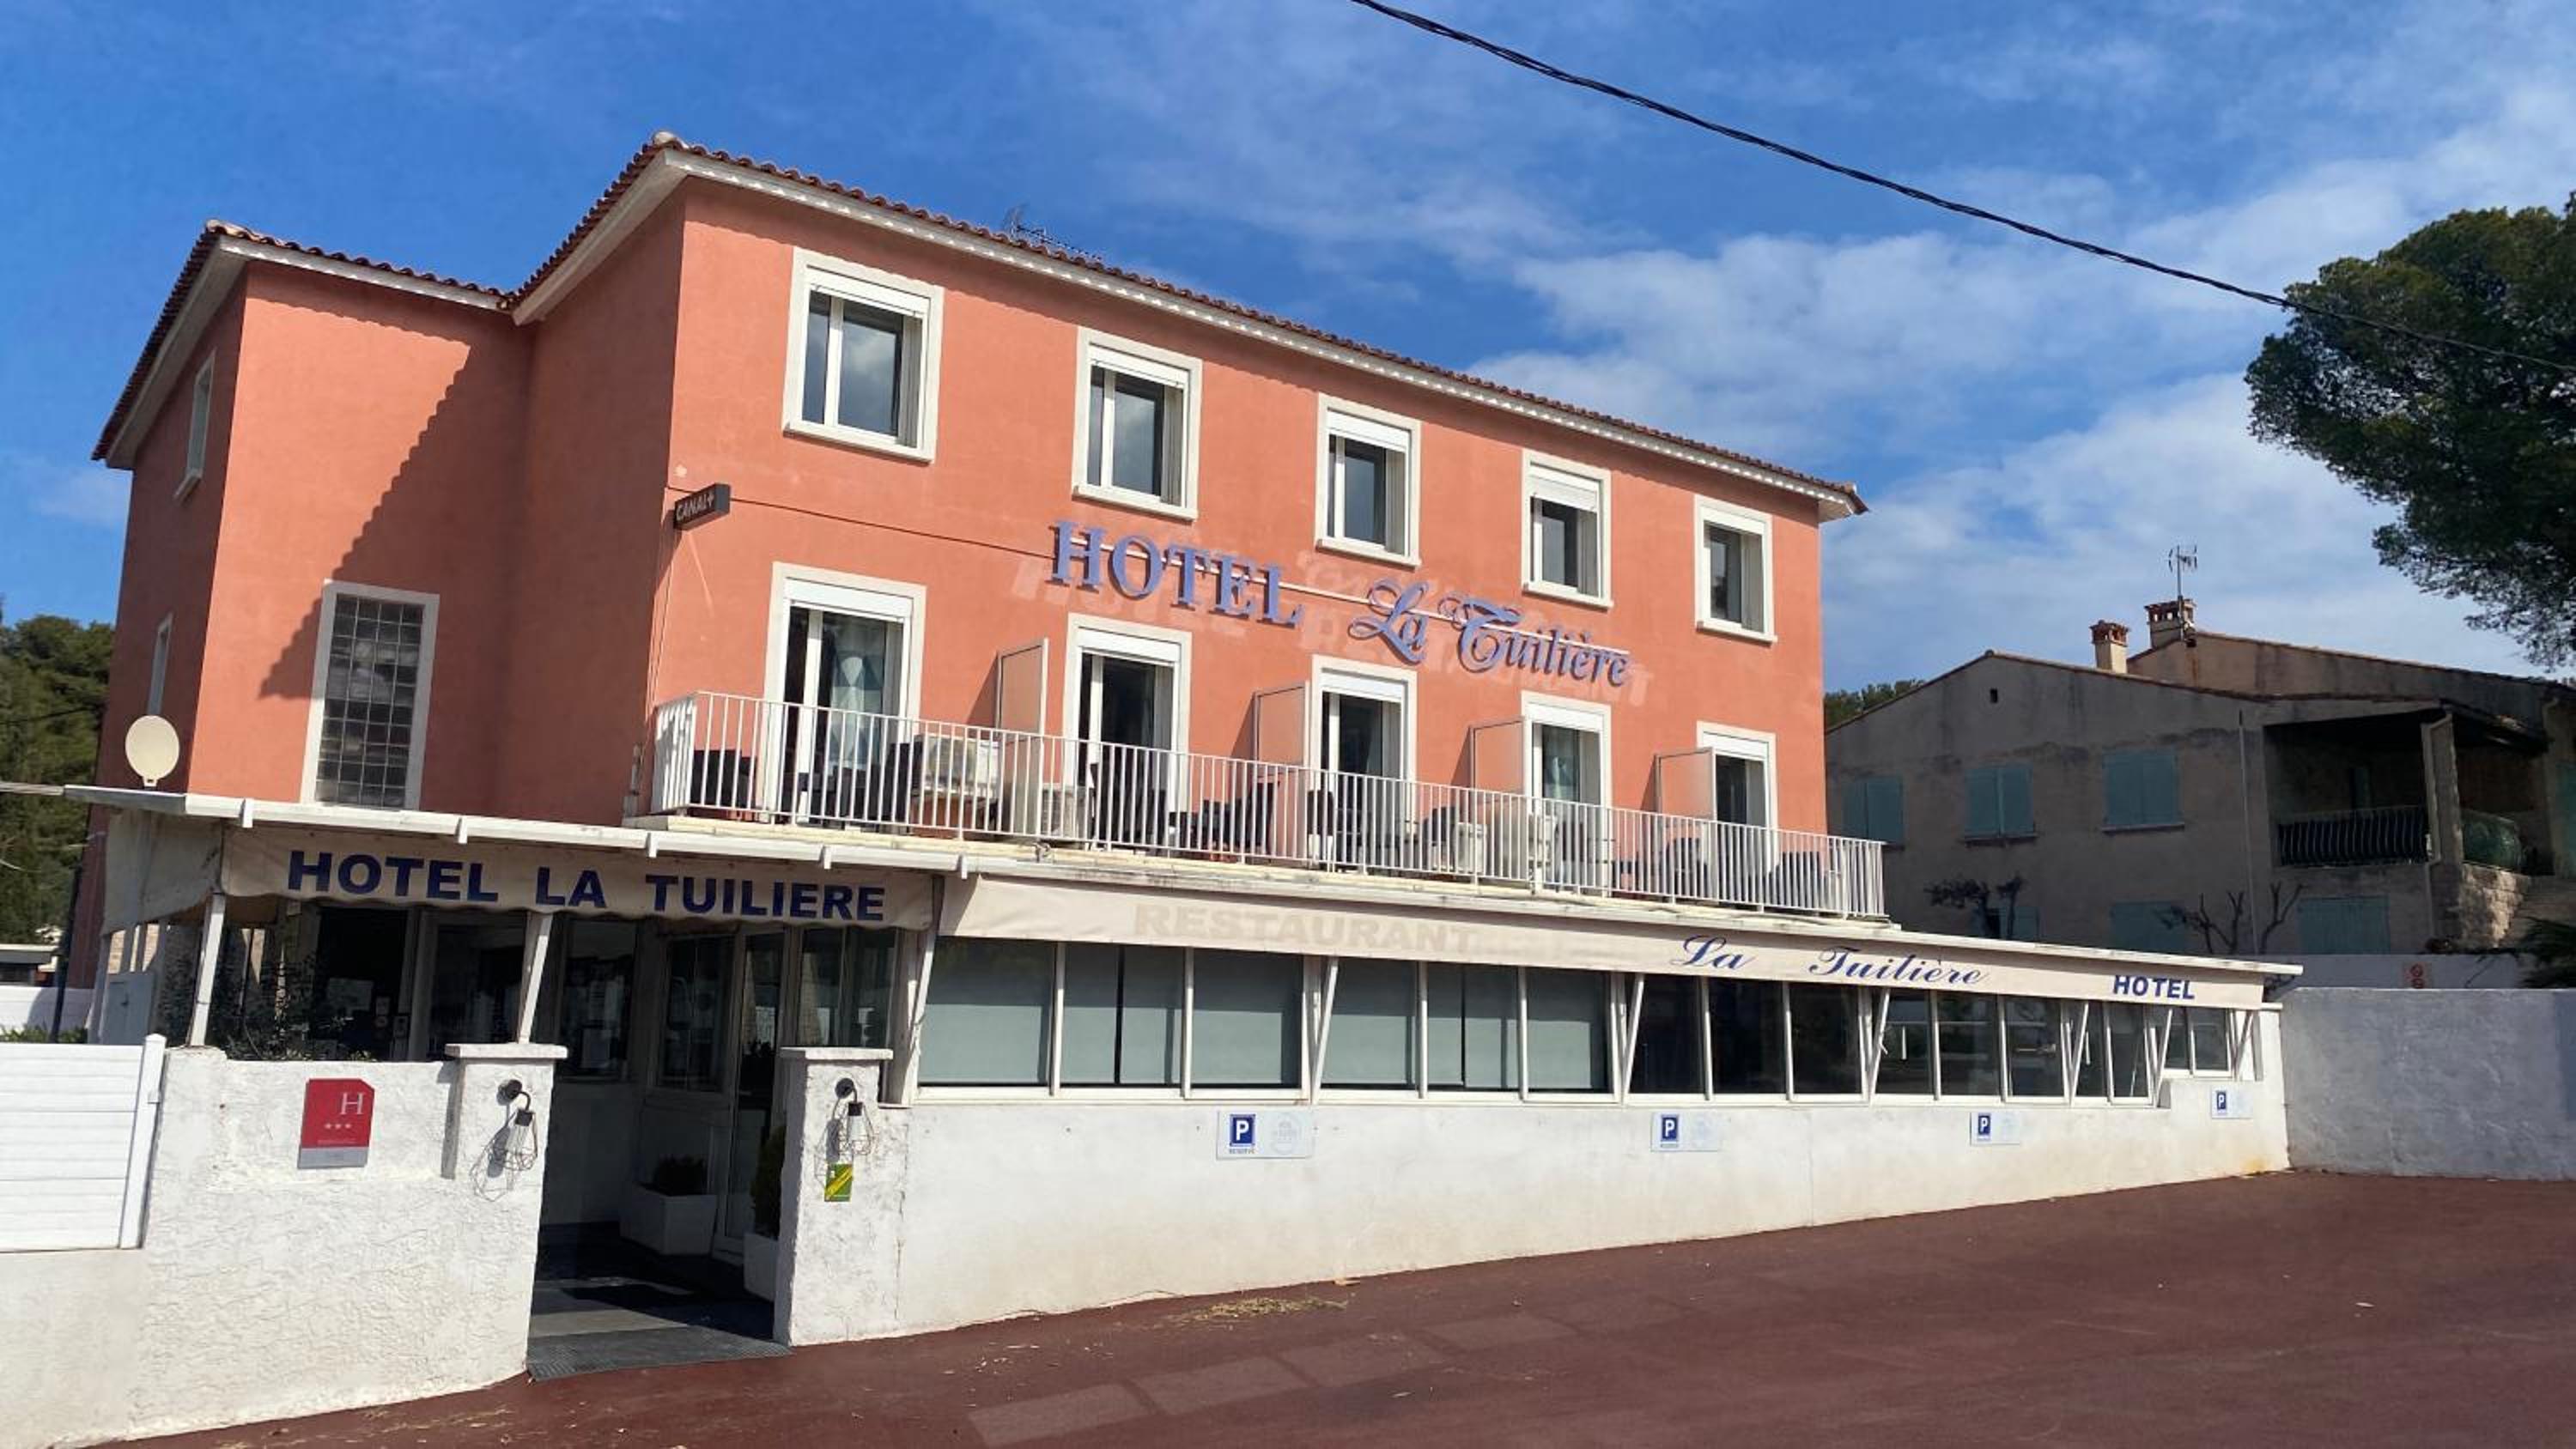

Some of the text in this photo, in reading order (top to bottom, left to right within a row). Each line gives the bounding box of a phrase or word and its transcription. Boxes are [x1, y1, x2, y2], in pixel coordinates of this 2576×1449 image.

[1046, 520, 1303, 628] HOTEL
[1348, 578, 1631, 687] La Tuilière
[287, 850, 885, 921] HOTEL LA TUILIERE
[1133, 904, 1475, 952] RESTAURANT
[1671, 935, 1990, 987] La Tuilière
[2112, 975, 2196, 1000] HOTEL
[340, 1092, 364, 1115] H
[2218, 1094, 2225, 1108] P
[1236, 1119, 1250, 1141] P
[1665, 1119, 1675, 1137] P
[1980, 1117, 1989, 1132] P
